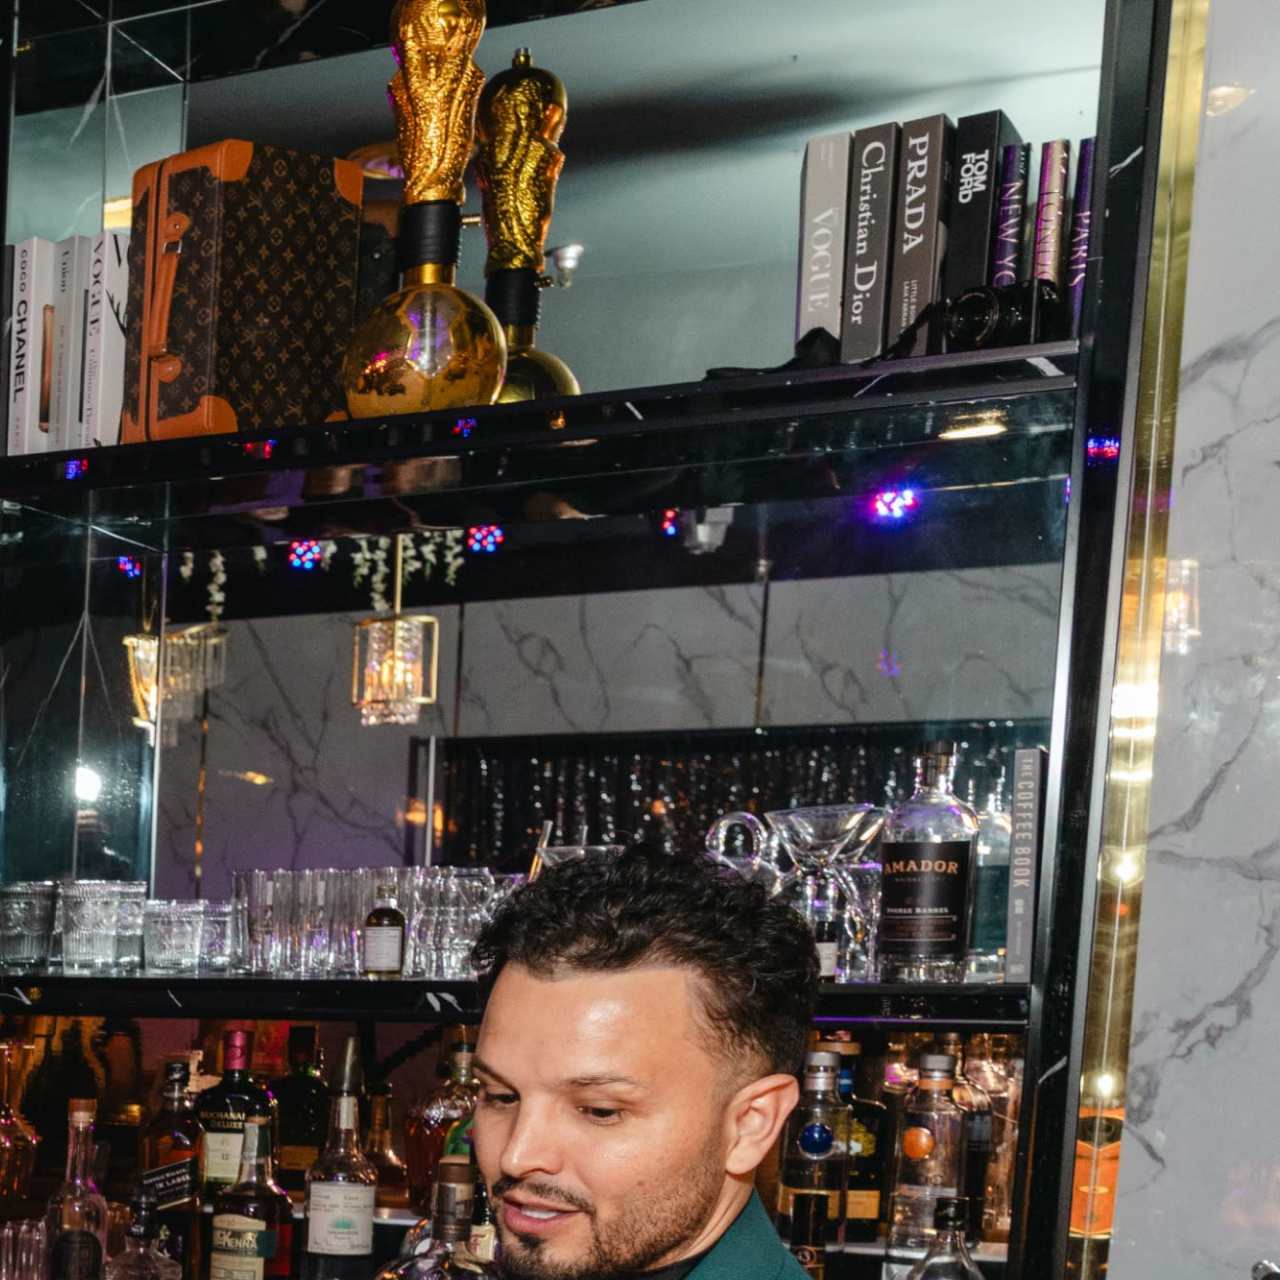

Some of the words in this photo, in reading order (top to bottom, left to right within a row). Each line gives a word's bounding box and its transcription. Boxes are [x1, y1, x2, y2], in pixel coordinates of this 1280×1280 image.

[856, 141, 886, 255] Christian
[902, 132, 930, 254] PRADA
[958, 153, 976, 203] FORD
[972, 150, 989, 192] TOM
[997, 182, 1024, 243] NEW
[18, 249, 28, 293] COCO
[807, 207, 839, 312] VOGUE
[993, 253, 1017, 288] YO
[1069, 211, 1092, 286] PARIS
[89, 241, 104, 337] VOGUE
[851, 261, 877, 325] Dior
[12, 300, 28, 403] CHANEL
[1021, 758, 1033, 777] THE
[1015, 781, 1034, 841] COFFEE
[884, 859, 959, 875] AMADOR
[1013, 847, 1031, 888] BOOK
